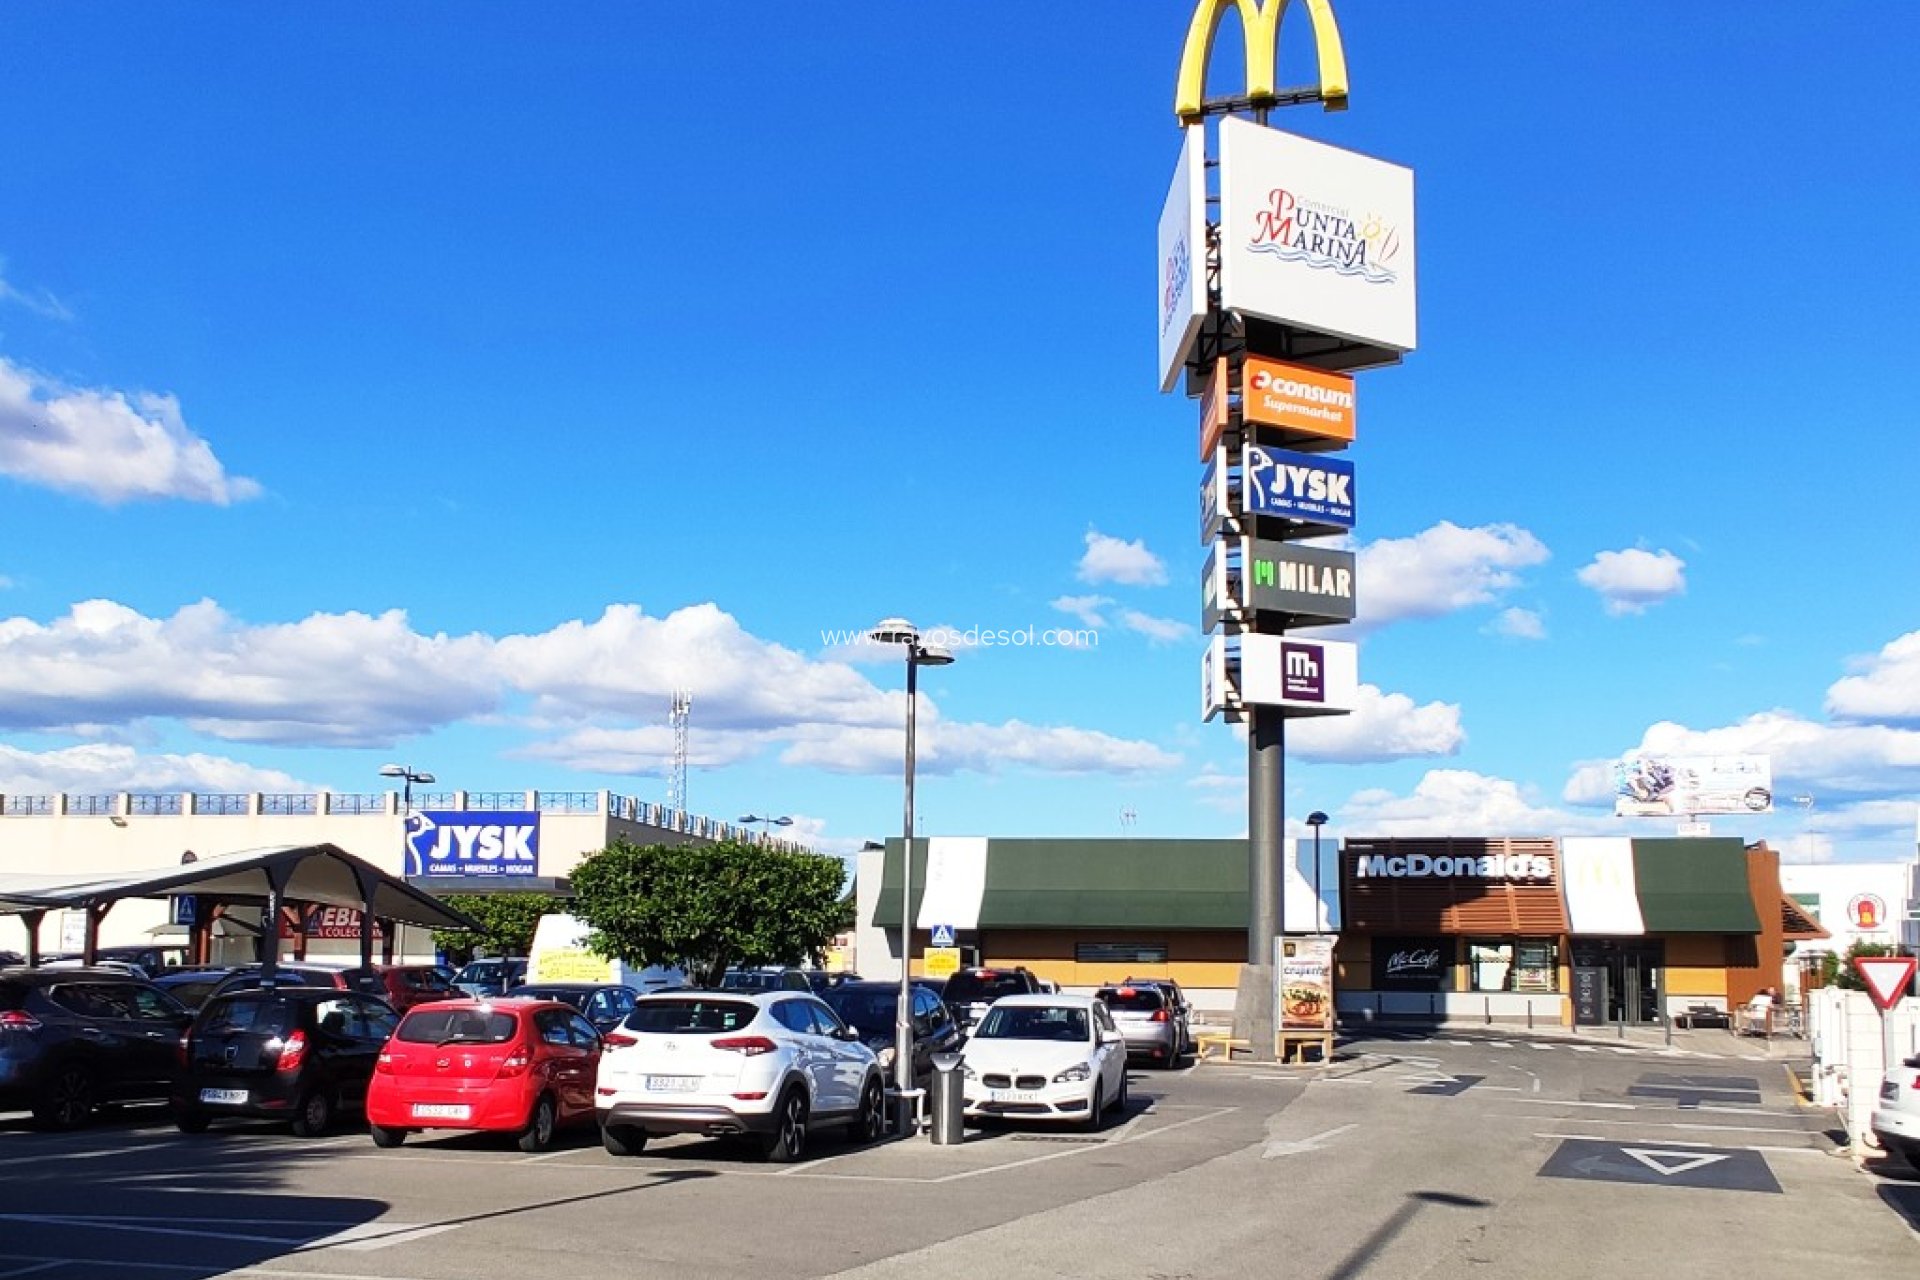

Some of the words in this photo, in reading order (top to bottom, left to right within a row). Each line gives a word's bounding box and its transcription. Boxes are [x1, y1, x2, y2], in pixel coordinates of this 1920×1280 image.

[1269, 189, 1357, 240] PUNTA
[1252, 211, 1367, 267] MARINA
[1264, 395, 1343, 422] Supermarket
[1272, 377, 1353, 408] consum
[1270, 464, 1351, 506] JYSK
[1279, 560, 1351, 598] MILAR
[429, 825, 535, 859] JYSK
[1356, 853, 1551, 879] McDonald's
